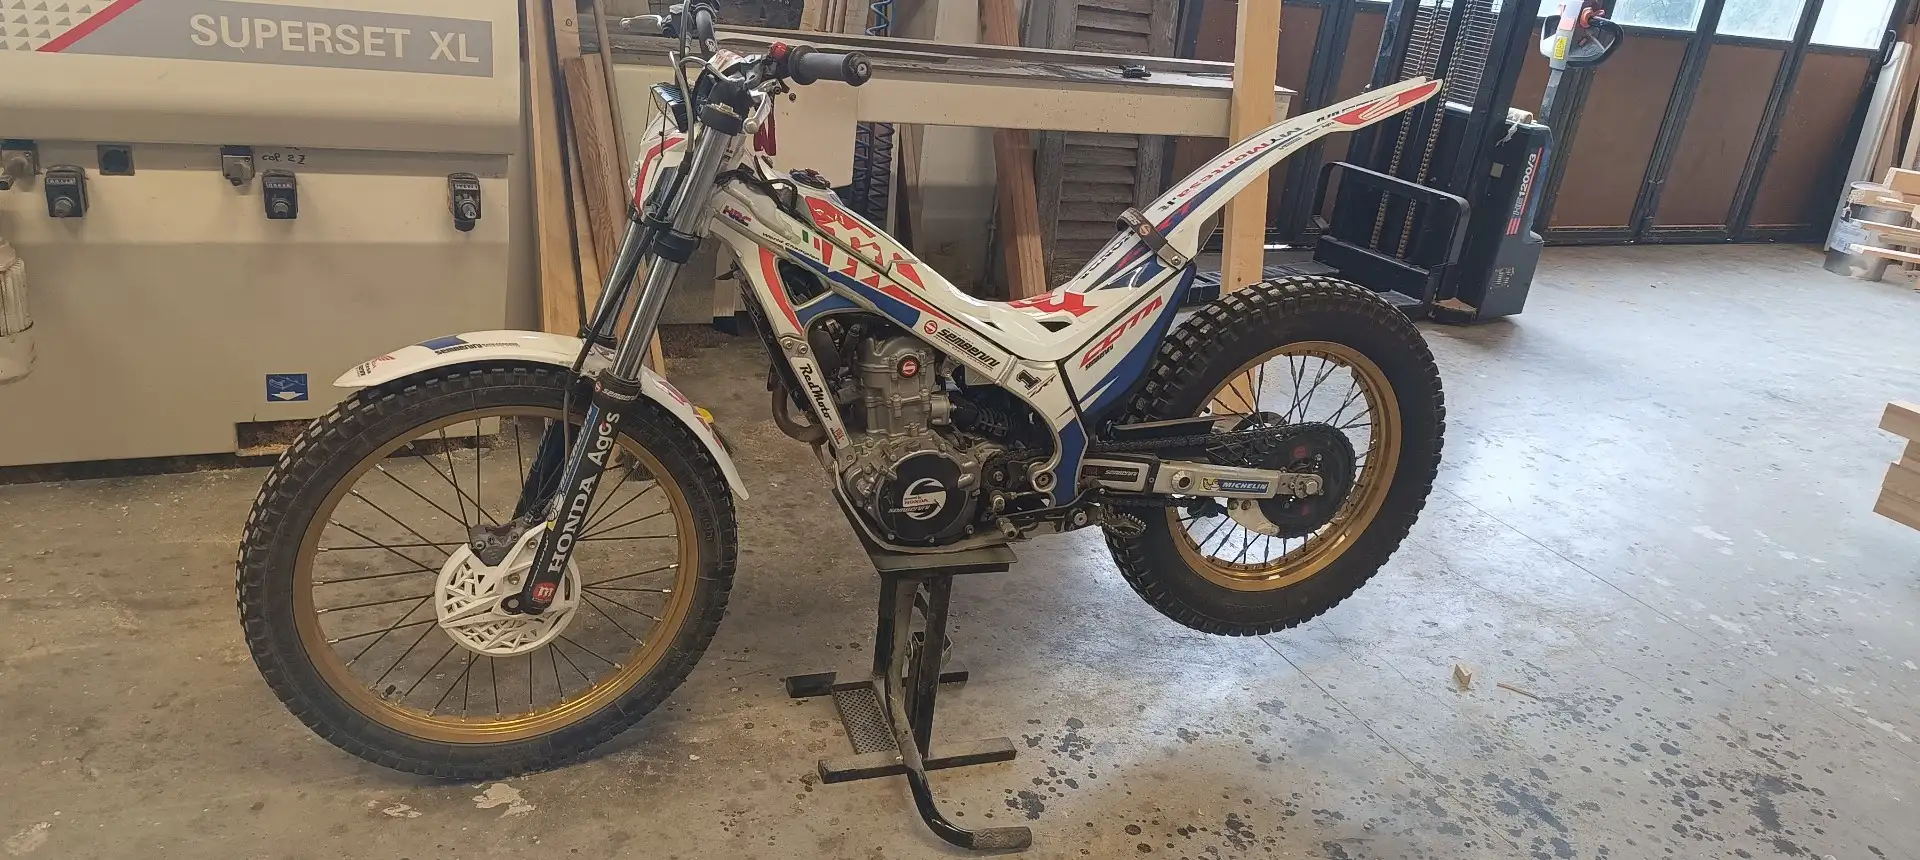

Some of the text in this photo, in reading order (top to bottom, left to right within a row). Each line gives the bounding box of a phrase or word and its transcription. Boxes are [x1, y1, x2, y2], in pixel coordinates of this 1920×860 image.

[189, 13, 480, 63] SUPERSET XL
[722, 204, 752, 227] HRC
[1221, 481, 1268, 490] MICHELIN
[547, 473, 598, 574] HONDA
